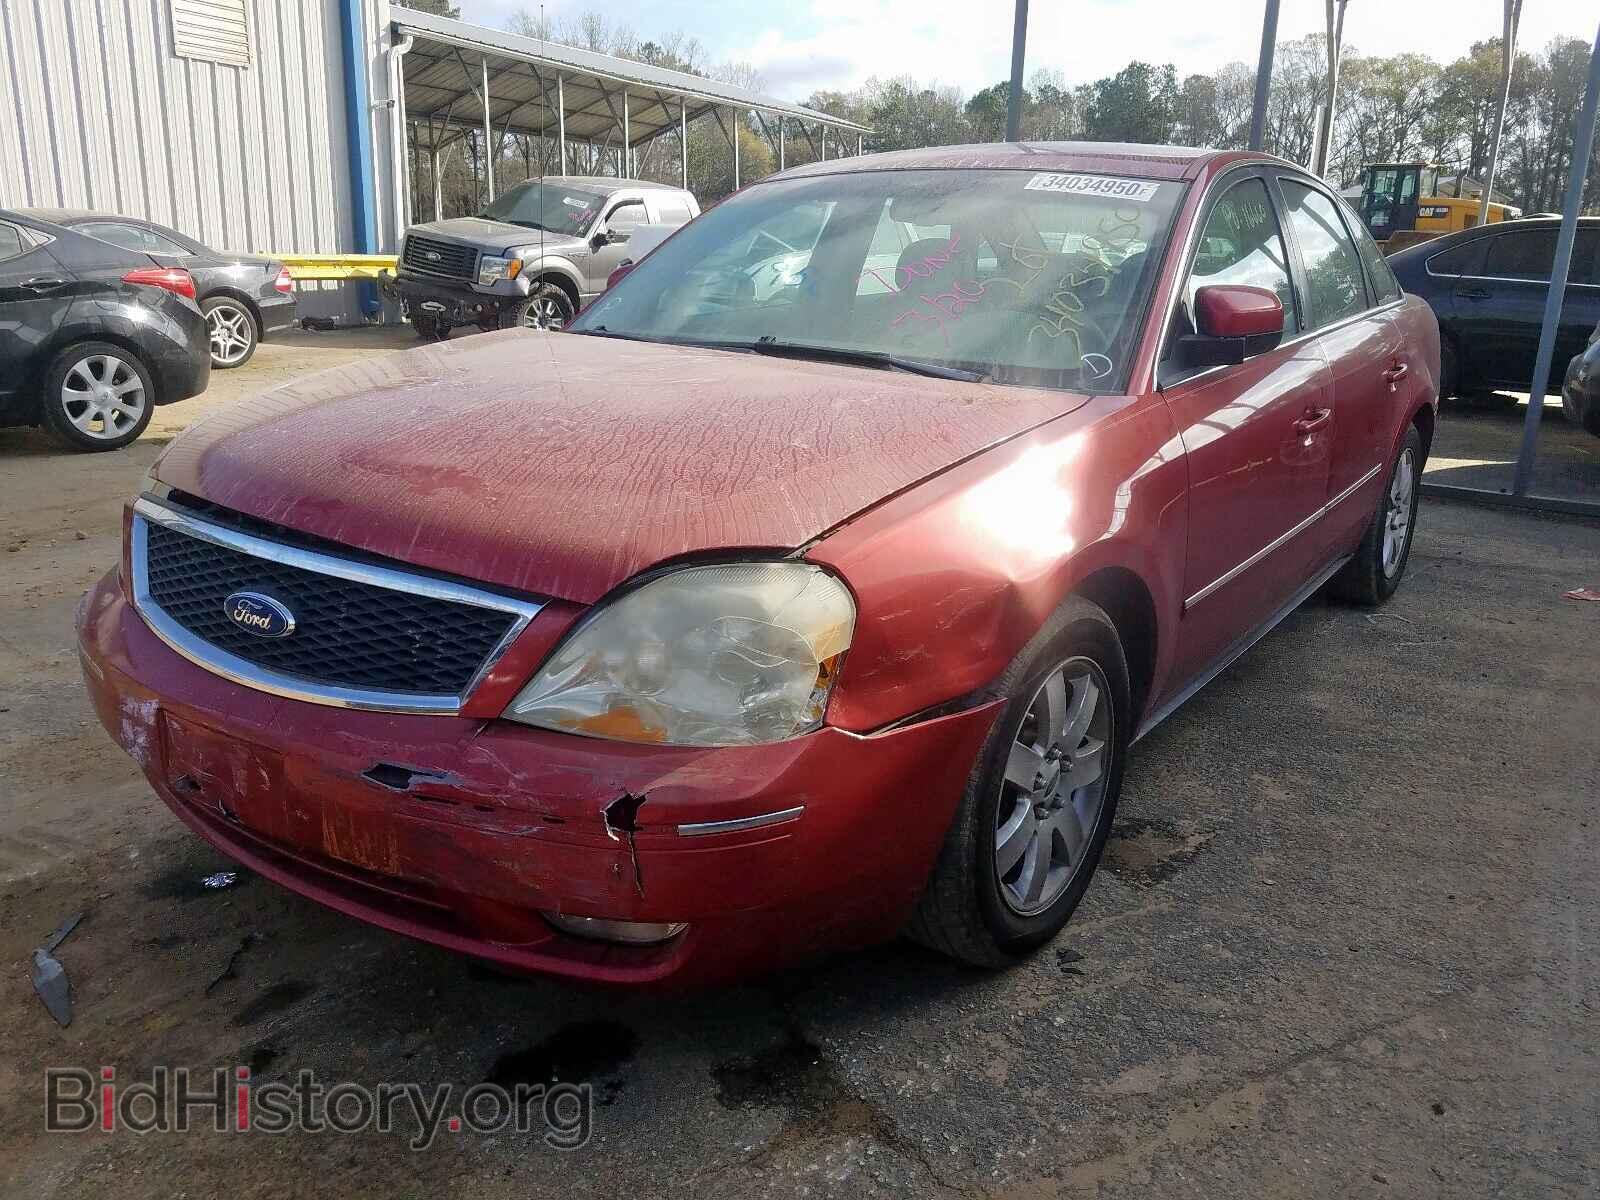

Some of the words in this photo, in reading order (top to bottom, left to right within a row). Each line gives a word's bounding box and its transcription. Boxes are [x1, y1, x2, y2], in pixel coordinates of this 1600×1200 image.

[1042, 174, 1141, 196] 34034950
[1419, 207, 1434, 217] CAT
[233, 599, 273, 630] Ford
